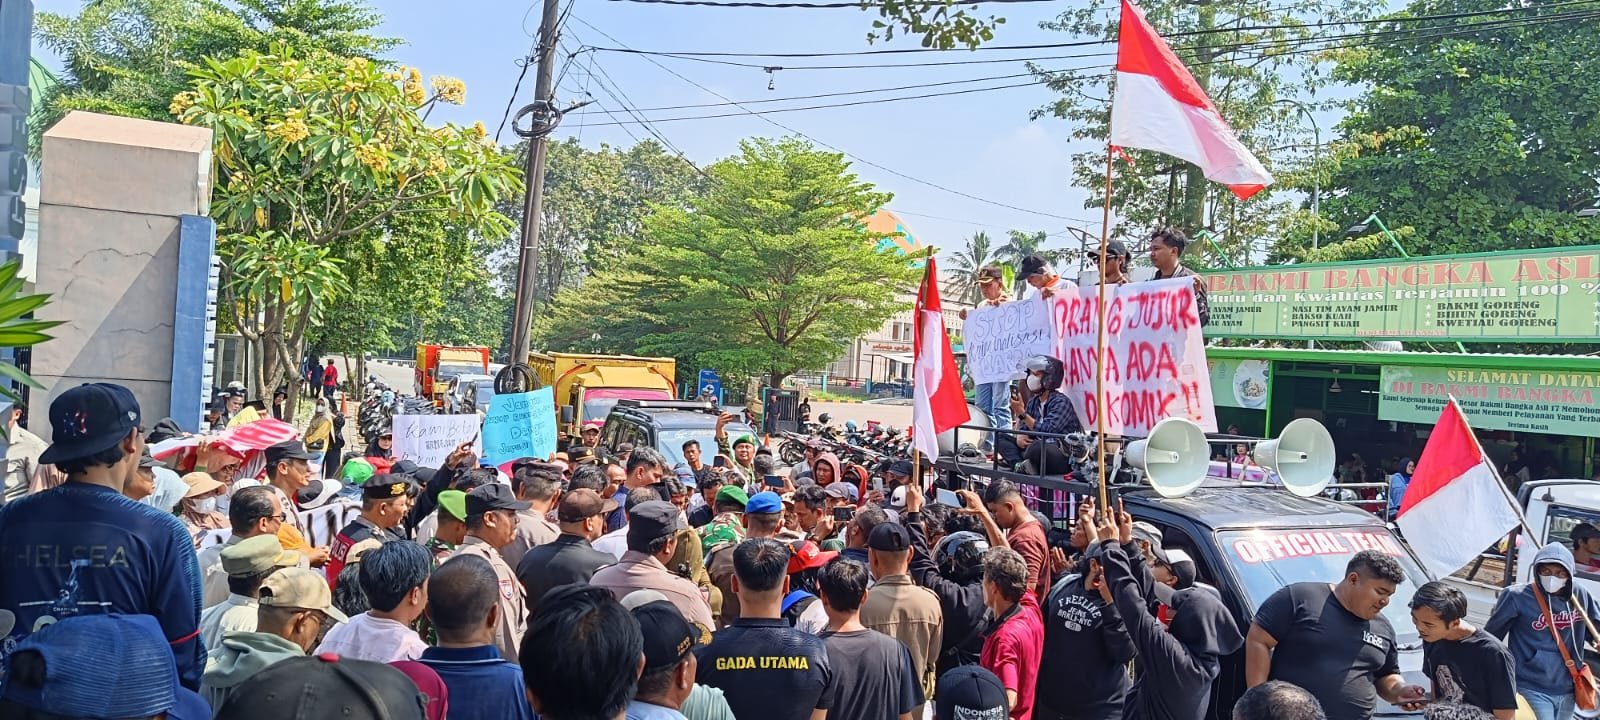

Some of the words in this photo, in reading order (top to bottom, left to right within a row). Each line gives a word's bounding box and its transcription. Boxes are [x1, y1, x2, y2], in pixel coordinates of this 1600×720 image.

[1207, 271, 1309, 292] BAKMI
[1323, 260, 1493, 289] BANGKA
[1207, 294, 1246, 303] Mutu
[1253, 293, 1287, 303] dan
[1294, 290, 1384, 303] Kwalitas
[1392, 287, 1506, 300] Terjamin
[1519, 284, 1569, 297] 100
[1054, 294, 1122, 339] ORANG
[1128, 287, 1197, 332] JUJUR
[1365, 304, 1398, 312] JAMUR
[1437, 302, 1479, 310] BAKMI
[1483, 301, 1540, 309] GORENG
[974, 300, 1034, 341] STOP
[1481, 310, 1537, 318] GORENG
[1292, 320, 1329, 328] PANGSIT
[1333, 320, 1360, 328] KUAH
[1436, 318, 1495, 327] KWETIAU
[1499, 318, 1558, 327] GORENG
[1126, 340, 1178, 383] ADA
[1447, 370, 1531, 385] SELAMAT
[1392, 381, 1414, 394] DI
[1420, 383, 1489, 398] BAKMI
[1497, 386, 1594, 404] BANGKA
[1106, 389, 1176, 431] KOMIK
[1505, 402, 1533, 411] Bangka
[1482, 409, 1513, 417] Memberi
[1514, 411, 1555, 420] Pelayanan
[1557, 414, 1576, 422] Yang
[1507, 421, 1529, 429] Terima
[1234, 531, 1350, 564] OFFICIAL
[1340, 532, 1401, 556] TEAM
[716, 656, 757, 671] GADA
[760, 655, 809, 670] UTAMA
[954, 704, 1004, 717] INDONESIA
